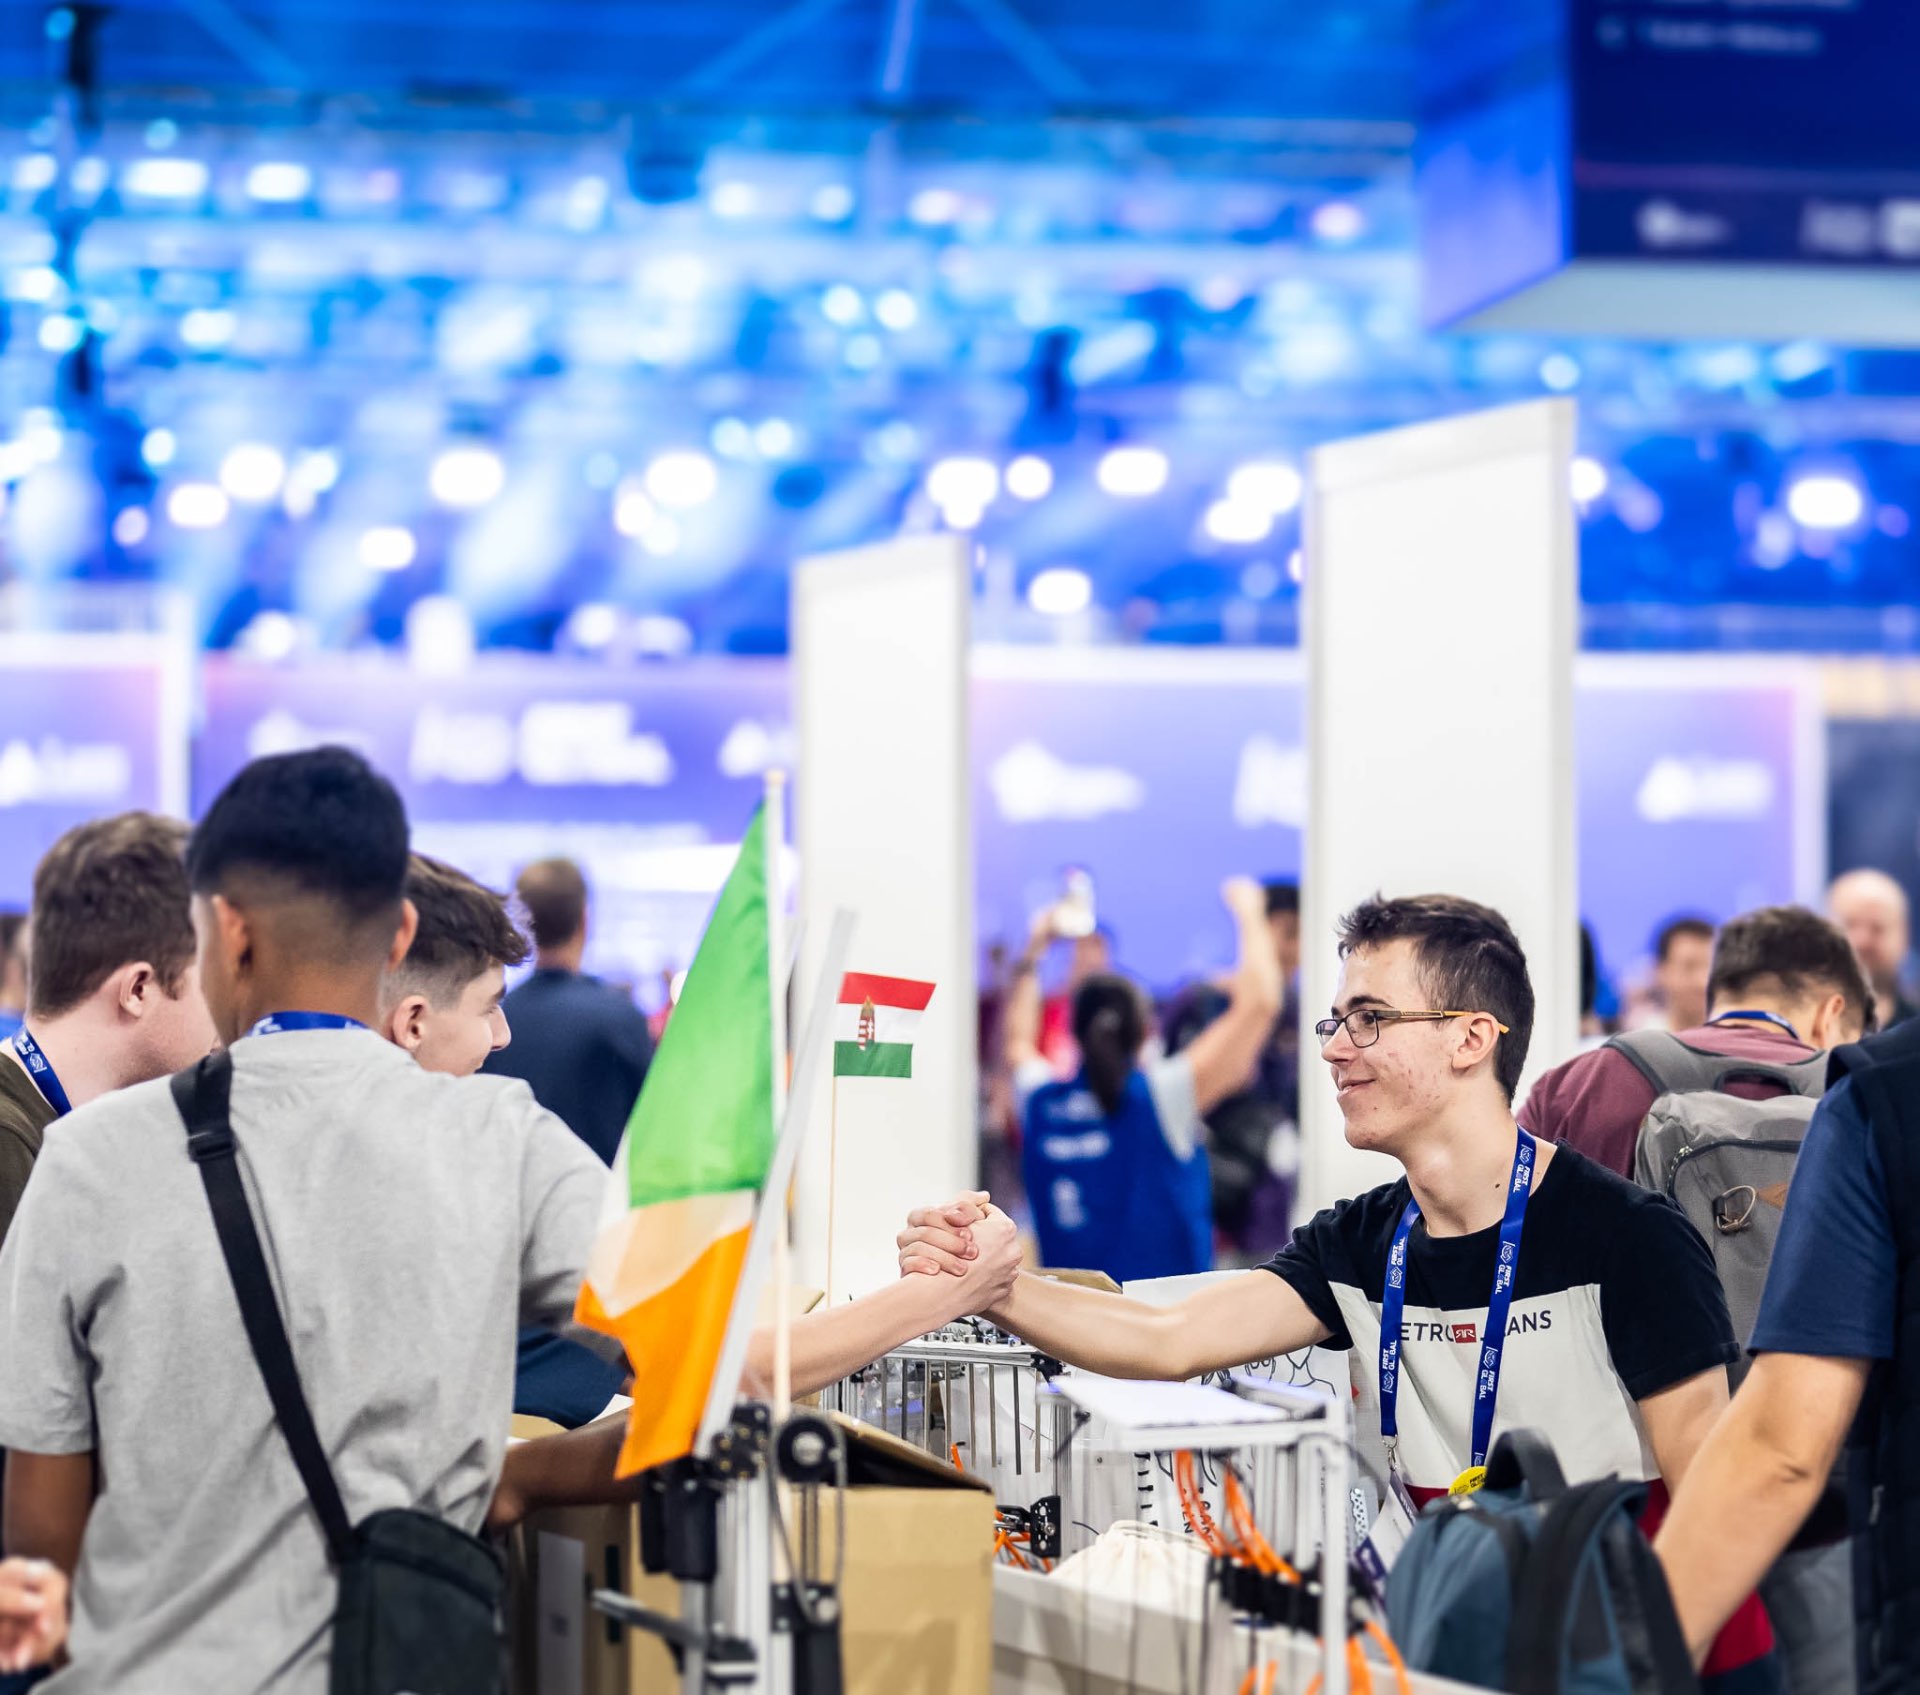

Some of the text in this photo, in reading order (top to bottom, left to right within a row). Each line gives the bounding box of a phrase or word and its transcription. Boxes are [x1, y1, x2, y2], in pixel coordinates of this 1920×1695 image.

[1522, 1166, 1531, 1186] FIRST
[1504, 1265, 1512, 1287] FIRST
[1401, 1322, 1454, 1342] ETR
[1488, 1371, 1496, 1392] FIRST
